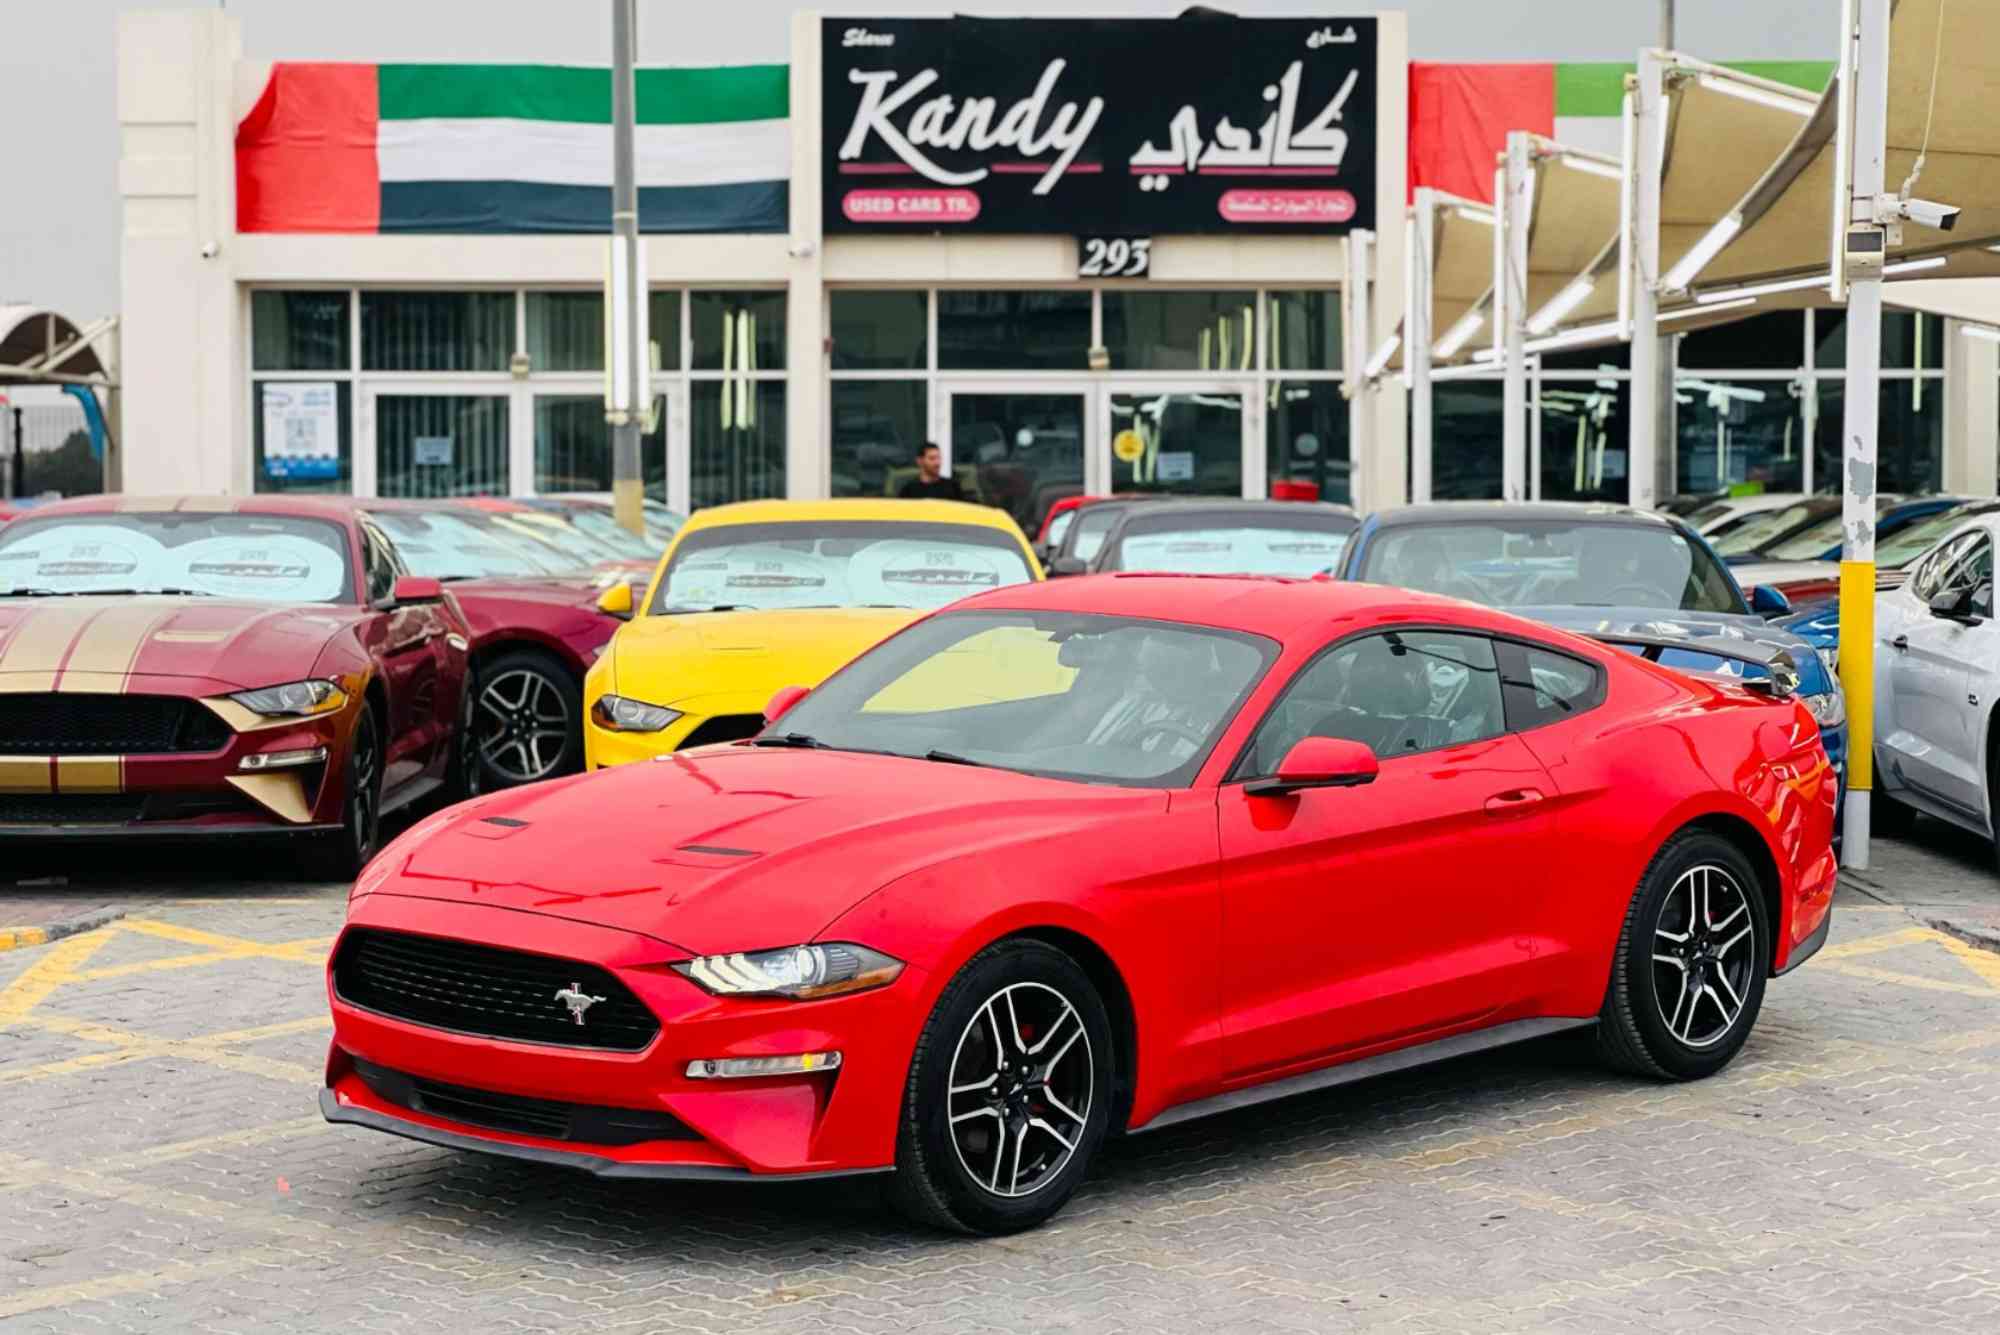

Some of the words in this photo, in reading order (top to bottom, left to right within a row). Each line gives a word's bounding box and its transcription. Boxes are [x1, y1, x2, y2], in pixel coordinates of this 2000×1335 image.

[838, 58, 1104, 195] Kandy
[1129, 59, 1359, 192] كاندي
[849, 197, 895, 213] USED
[897, 197, 941, 213] CARS
[1079, 238, 1151, 276] 293
